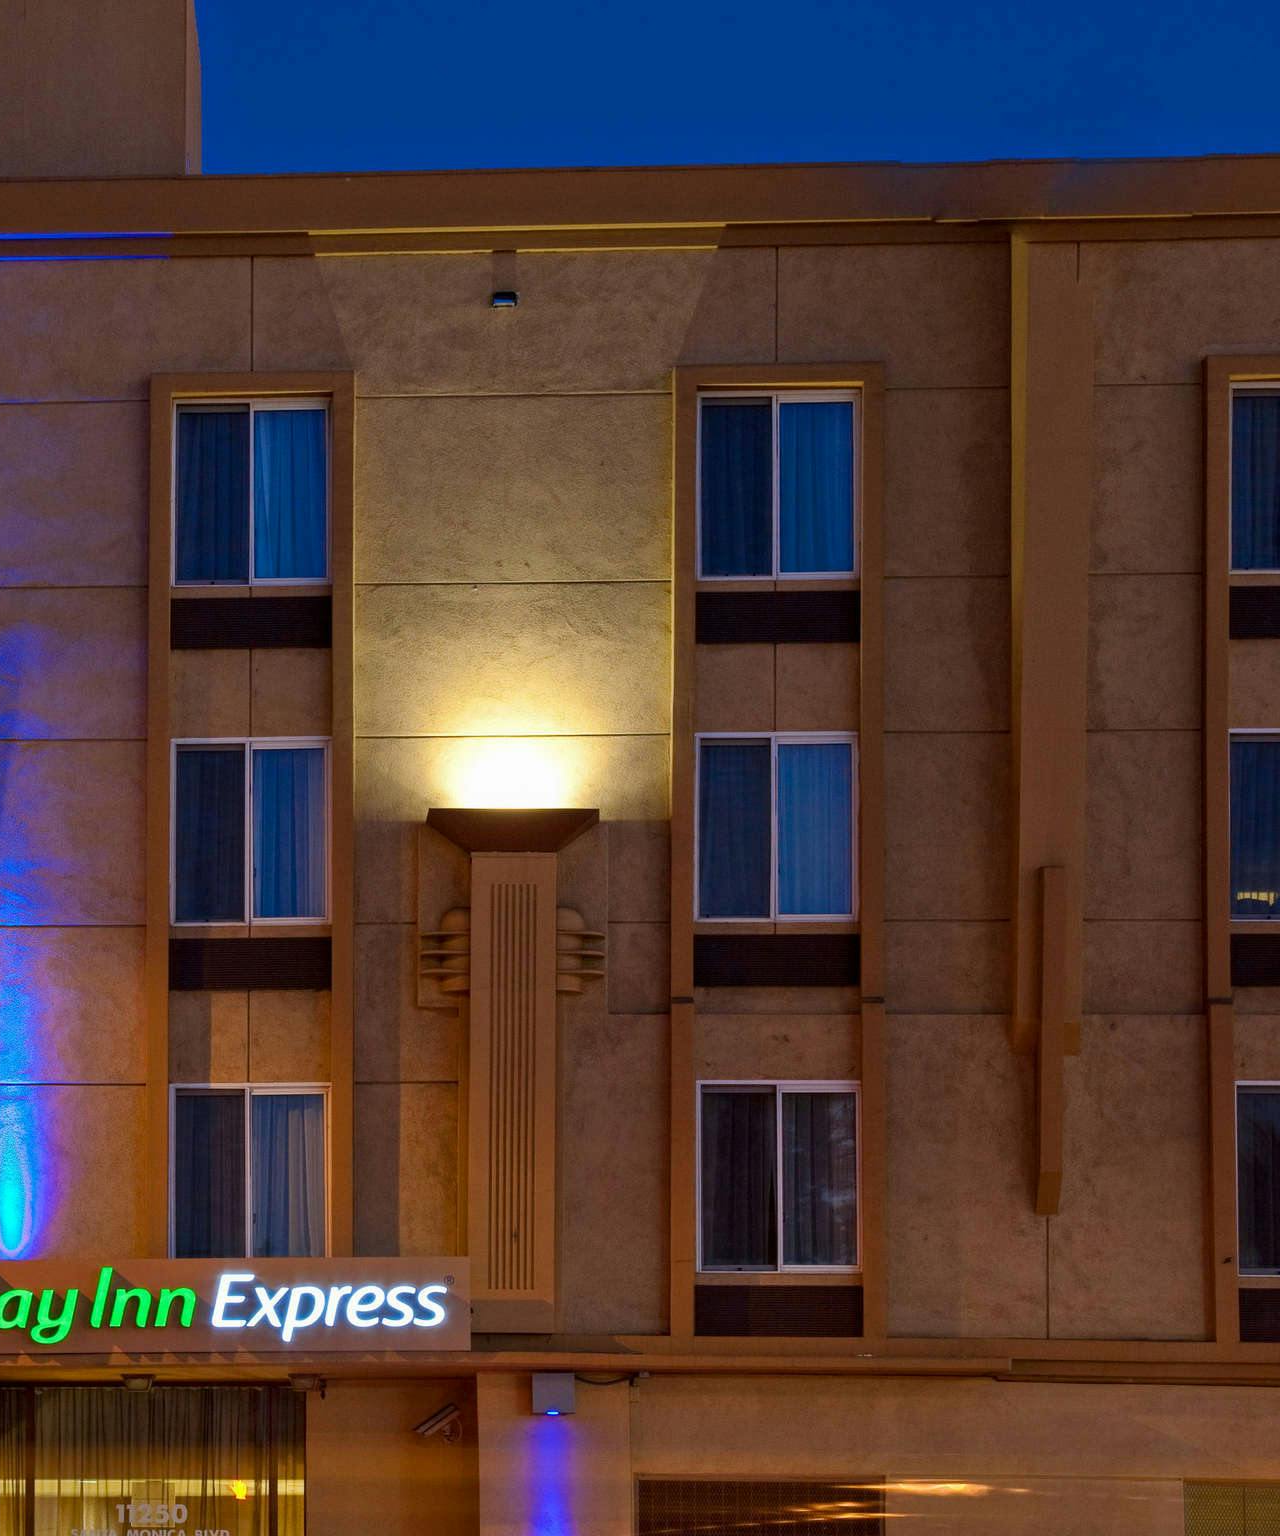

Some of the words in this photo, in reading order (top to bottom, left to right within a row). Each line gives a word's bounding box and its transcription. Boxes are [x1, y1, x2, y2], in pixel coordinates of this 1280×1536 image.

[90, 1266, 196, 1328] Inn
[210, 1273, 448, 1343] Express
[116, 1503, 188, 1524] 11250
